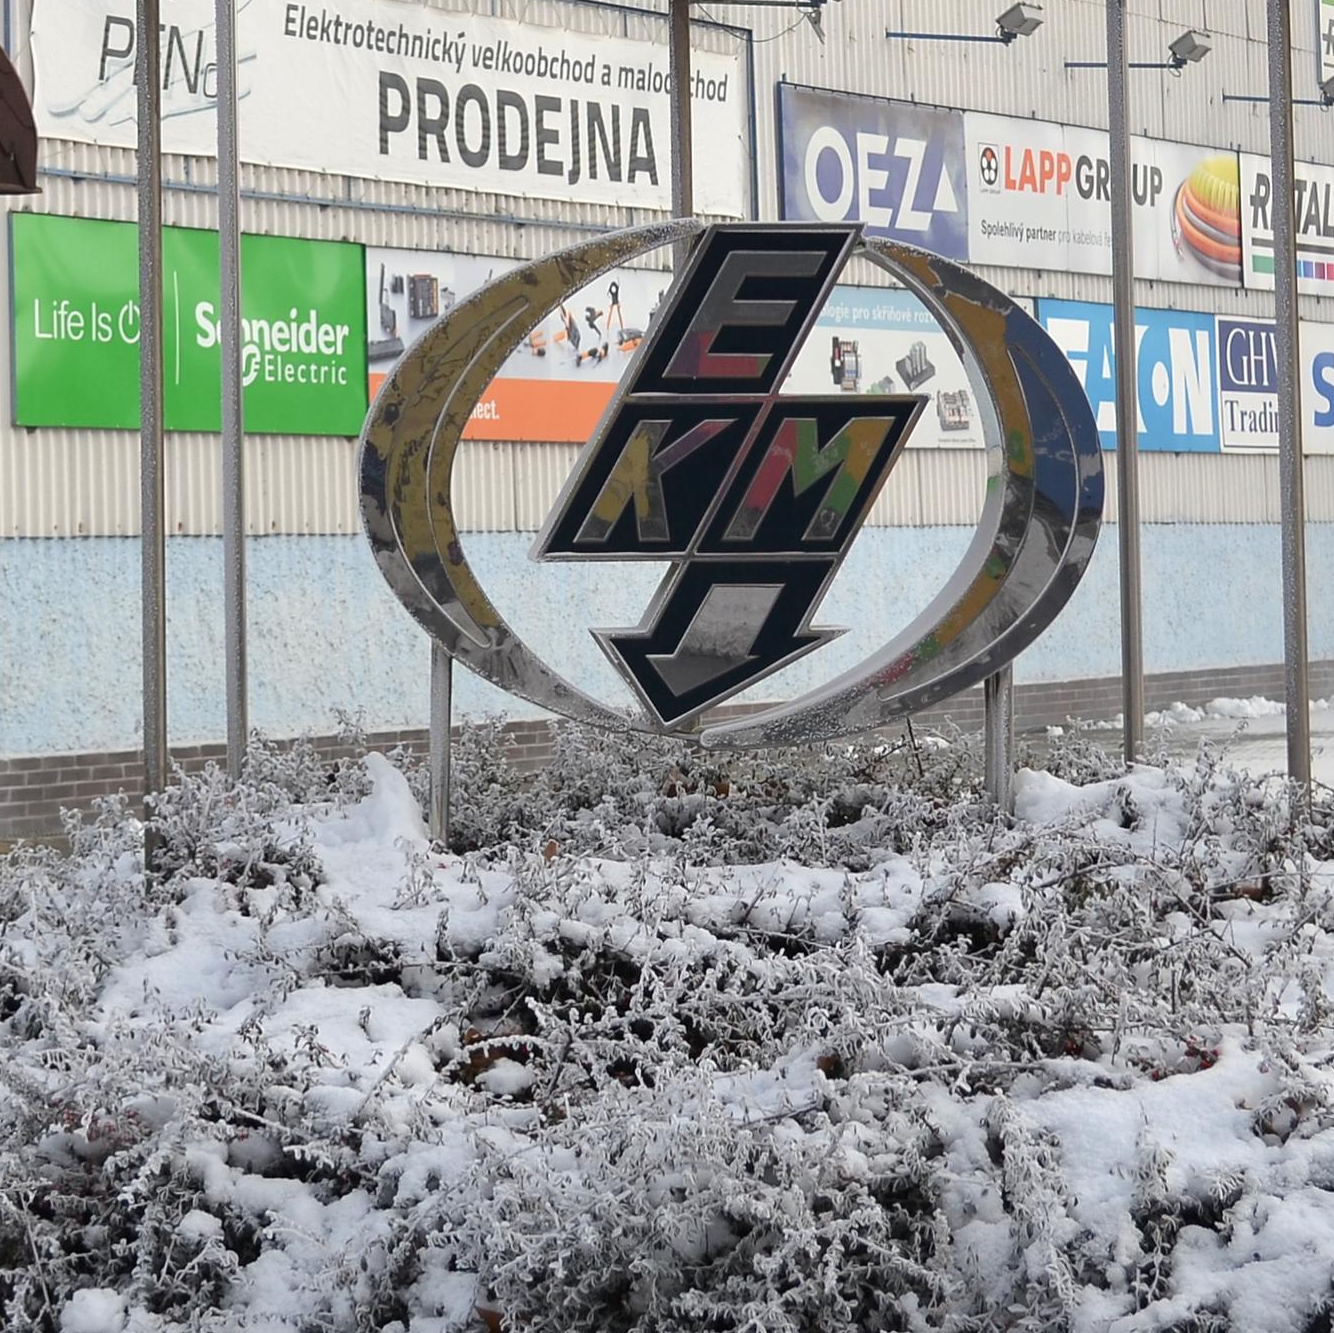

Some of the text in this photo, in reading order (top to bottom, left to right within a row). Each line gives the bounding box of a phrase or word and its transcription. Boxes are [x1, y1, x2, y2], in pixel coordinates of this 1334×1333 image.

[284, 3, 466, 74] Elektrotechnický
[472, 41, 596, 86] velkoobchod
[601, 63, 611, 84] a
[379, 71, 659, 186] PRODEJNA
[805, 126, 933, 231] OEZ
[1076, 155, 1163, 207] GRUP
[981, 219, 1024, 243] Spolehlivý
[1026, 227, 1057, 243] partner
[1058, 232, 1071, 246] pro
[34, 298, 84, 341] Life
[91, 302, 113, 342] Is
[853, 307, 869, 324] pro
[264, 354, 348, 385] Electric
